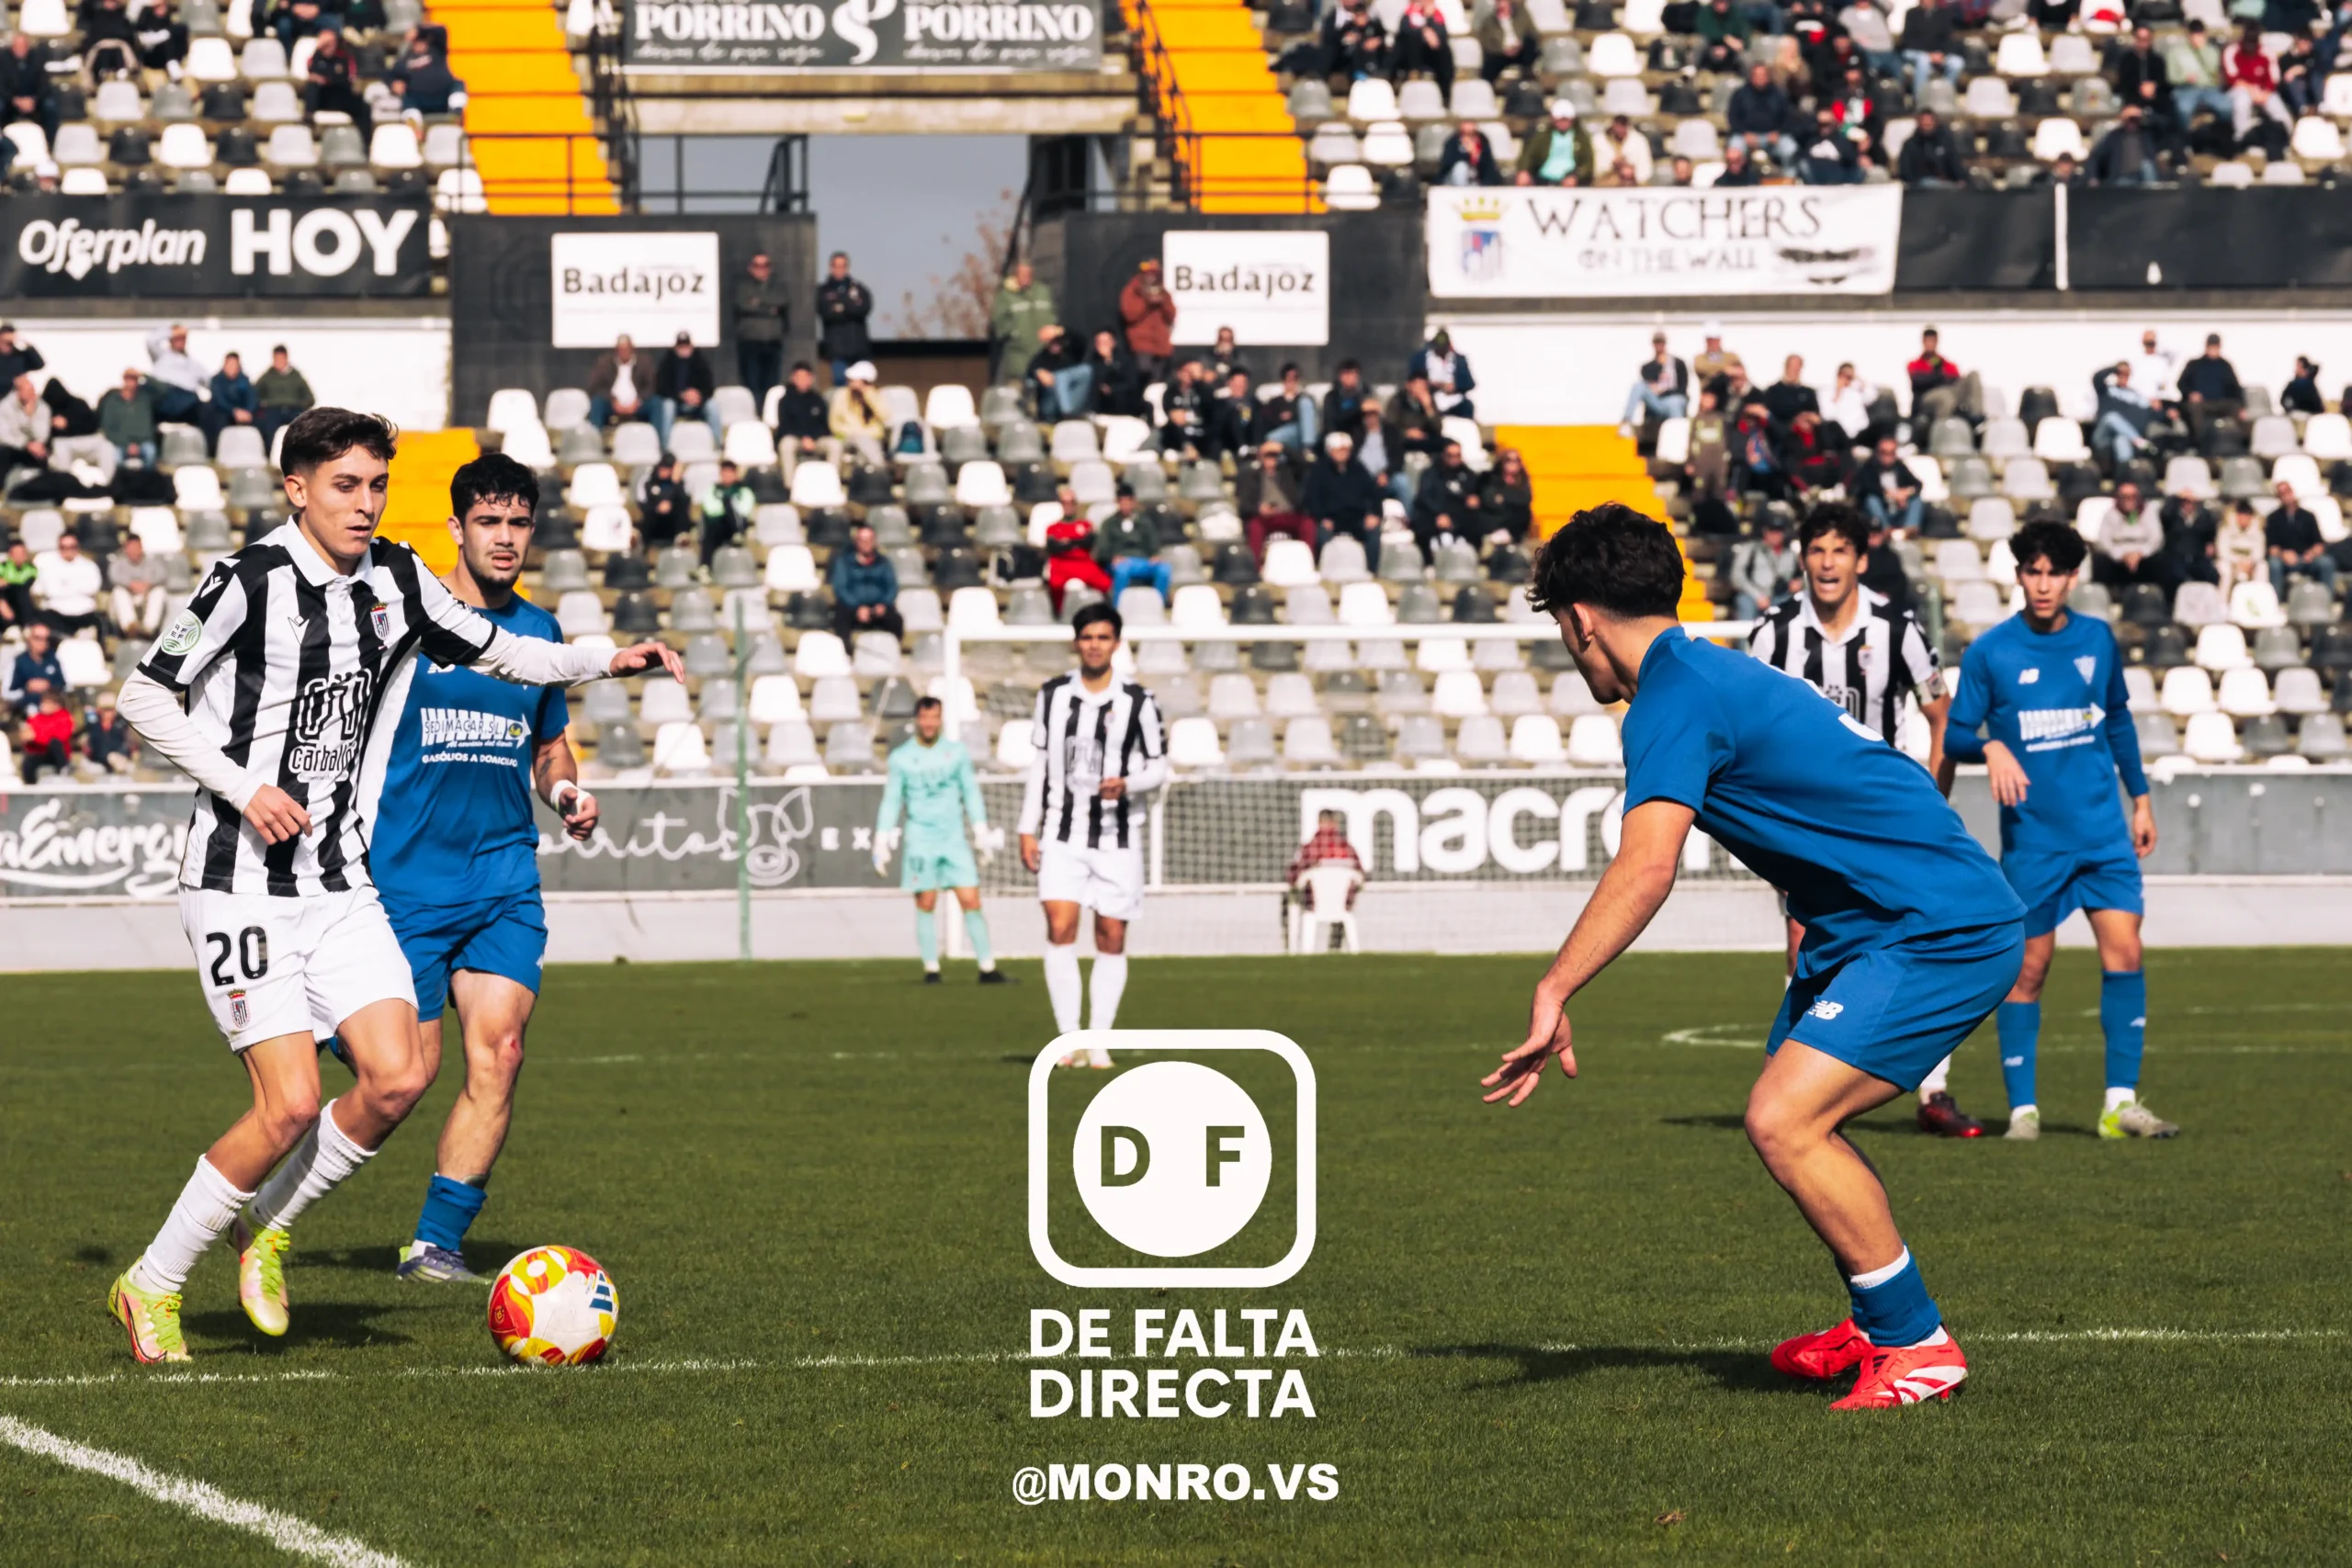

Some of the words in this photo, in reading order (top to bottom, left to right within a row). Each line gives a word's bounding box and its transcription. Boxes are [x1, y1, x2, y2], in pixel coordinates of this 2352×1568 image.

[1525, 196, 1821, 239] WATCHERS
[18, 218, 207, 279] Oferplan
[231, 208, 418, 276] HOY
[1629, 247, 1679, 273] THE
[1685, 247, 1758, 271] WALL
[563, 266, 704, 300] Badajoz
[1174, 265, 1314, 299] Badajoz
[206, 926, 268, 987] 20
